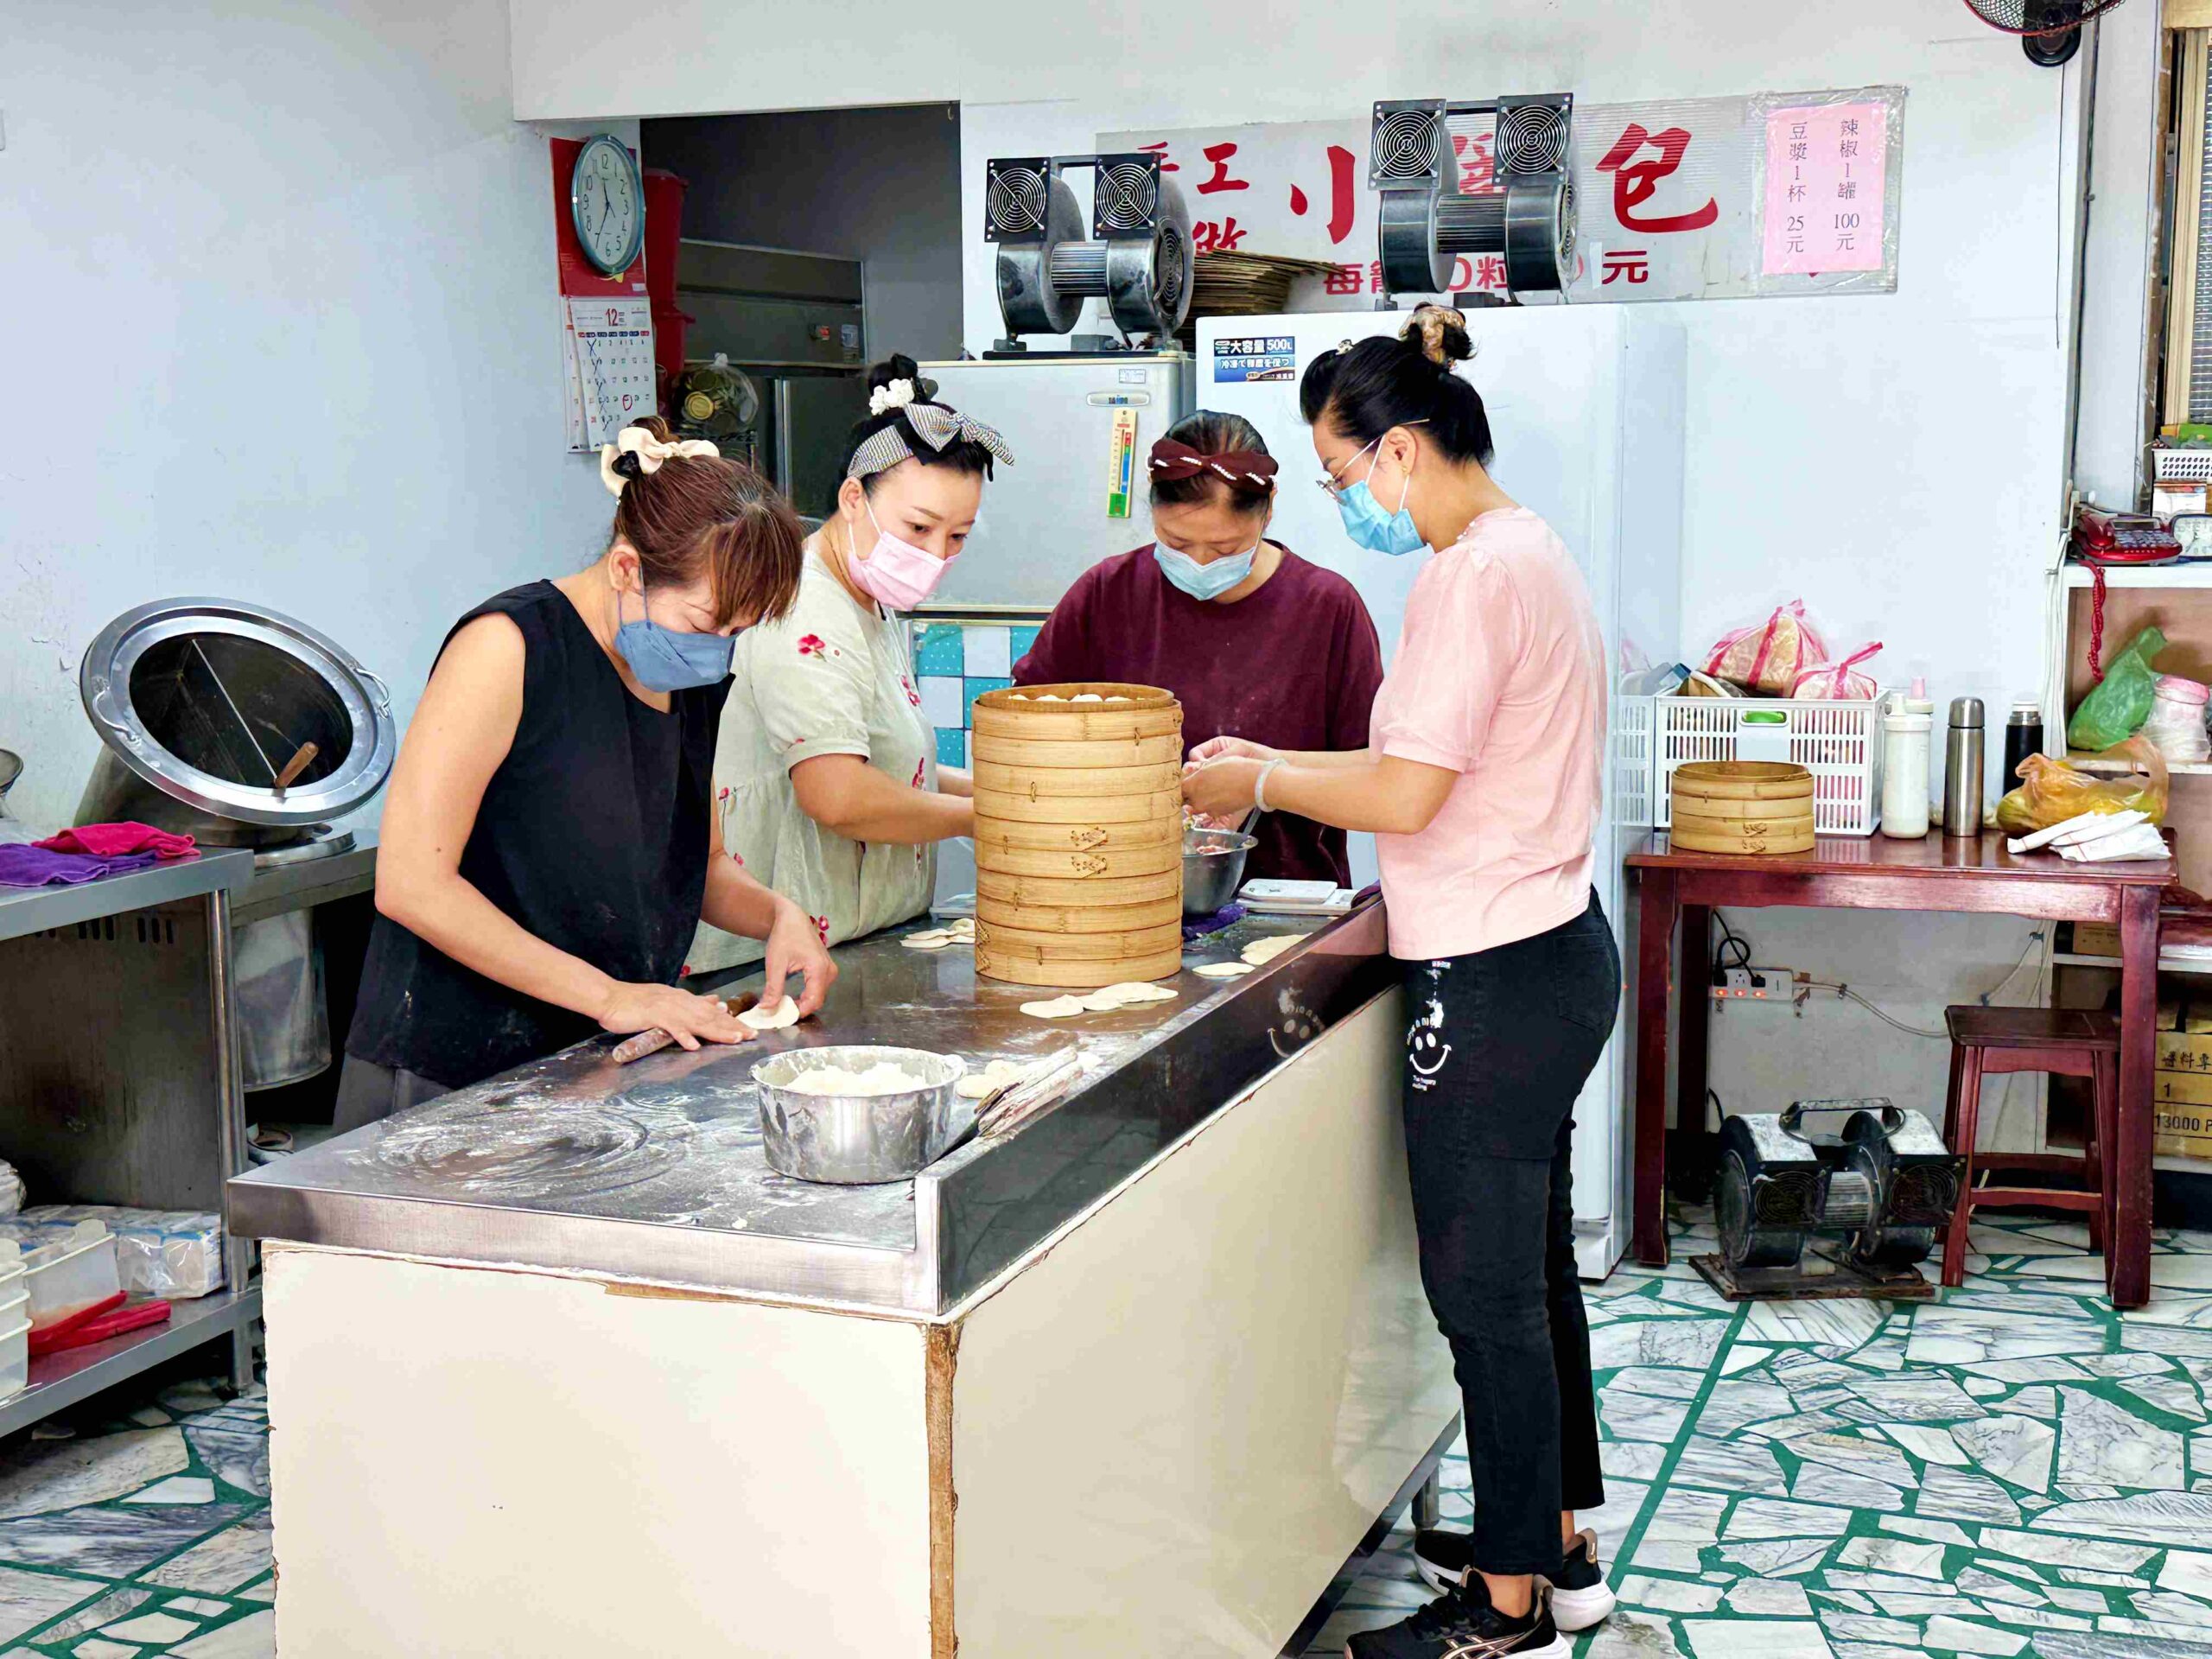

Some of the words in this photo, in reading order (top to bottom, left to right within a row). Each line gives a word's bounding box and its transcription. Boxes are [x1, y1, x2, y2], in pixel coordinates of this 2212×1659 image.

[1786, 215, 1805, 253] 25元
[1834, 213, 1860, 251] 100元
[606, 308, 619, 326] 12
[2164, 1083, 2171, 1097] 1
